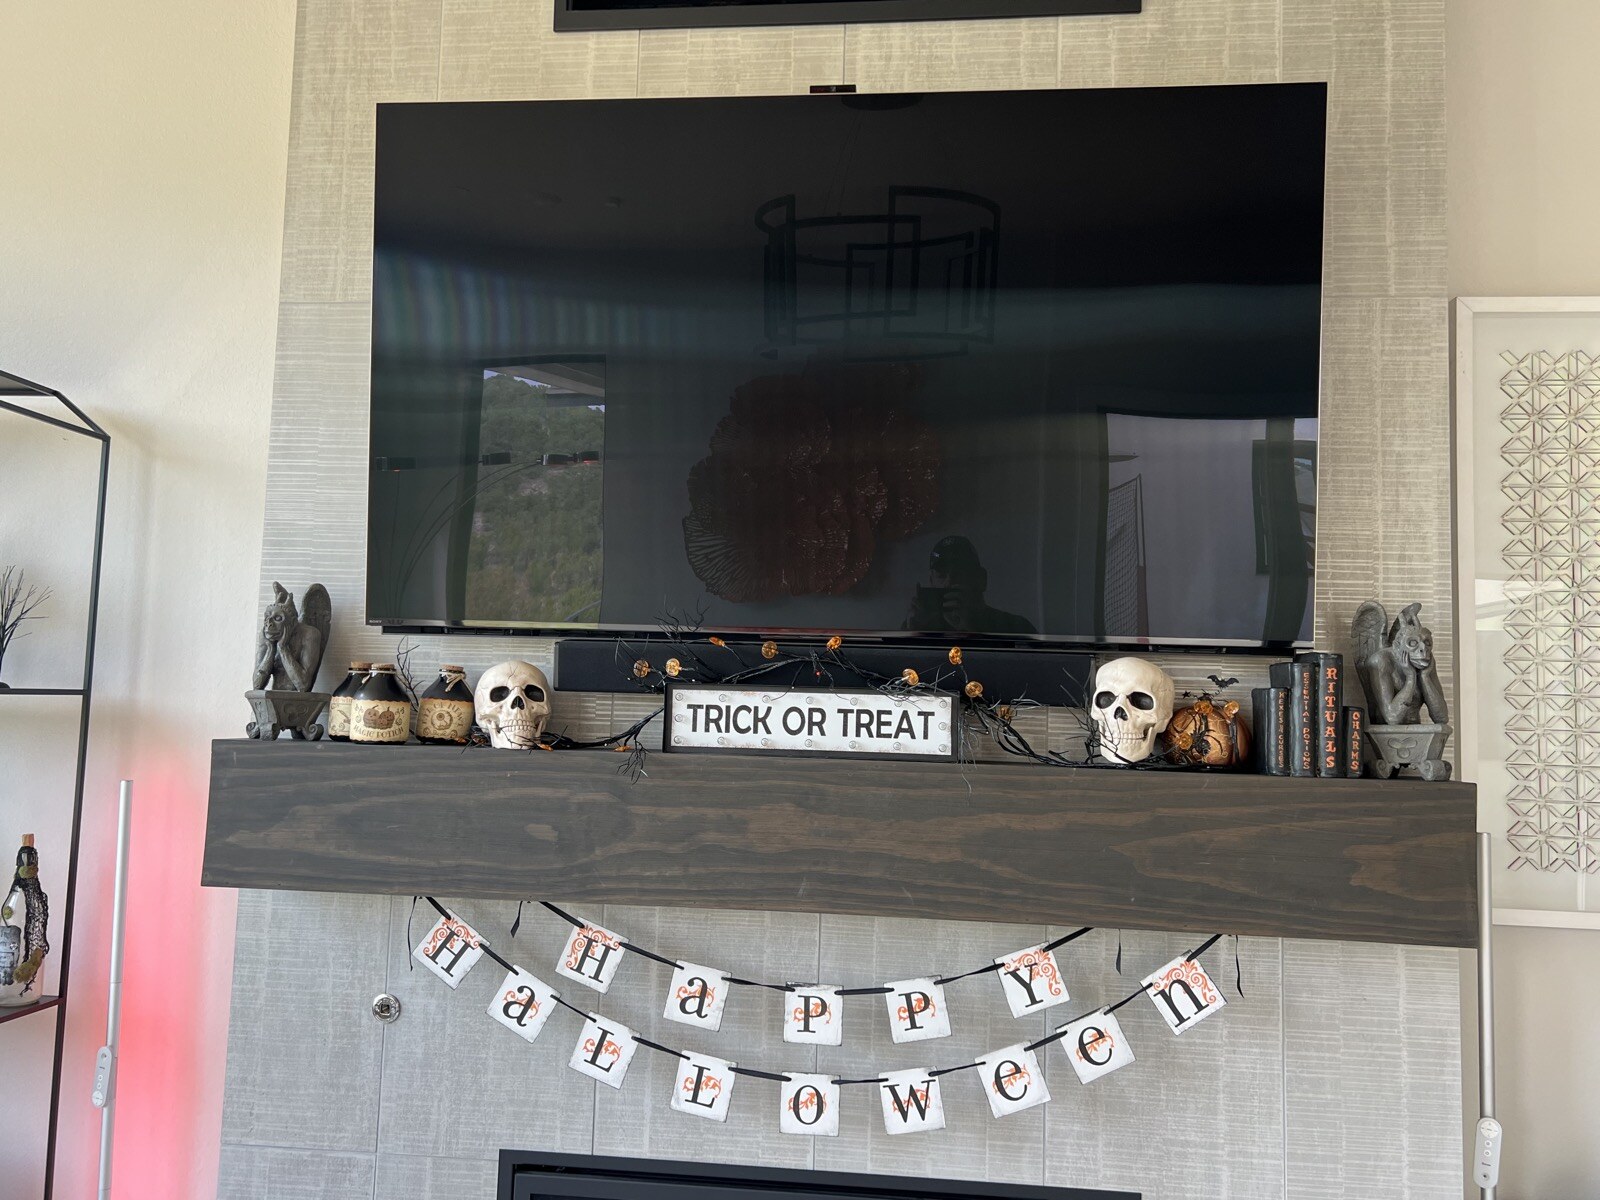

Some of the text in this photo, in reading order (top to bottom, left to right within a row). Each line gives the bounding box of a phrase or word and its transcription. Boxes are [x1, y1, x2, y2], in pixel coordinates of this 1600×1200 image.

[686, 703, 936, 740] TRICK OR TREAT
[1302, 672, 1311, 770] ESSENTIAL POTIONS
[1324, 667, 1338, 768] RITUALS
[1350, 711, 1361, 771] CHARMS
